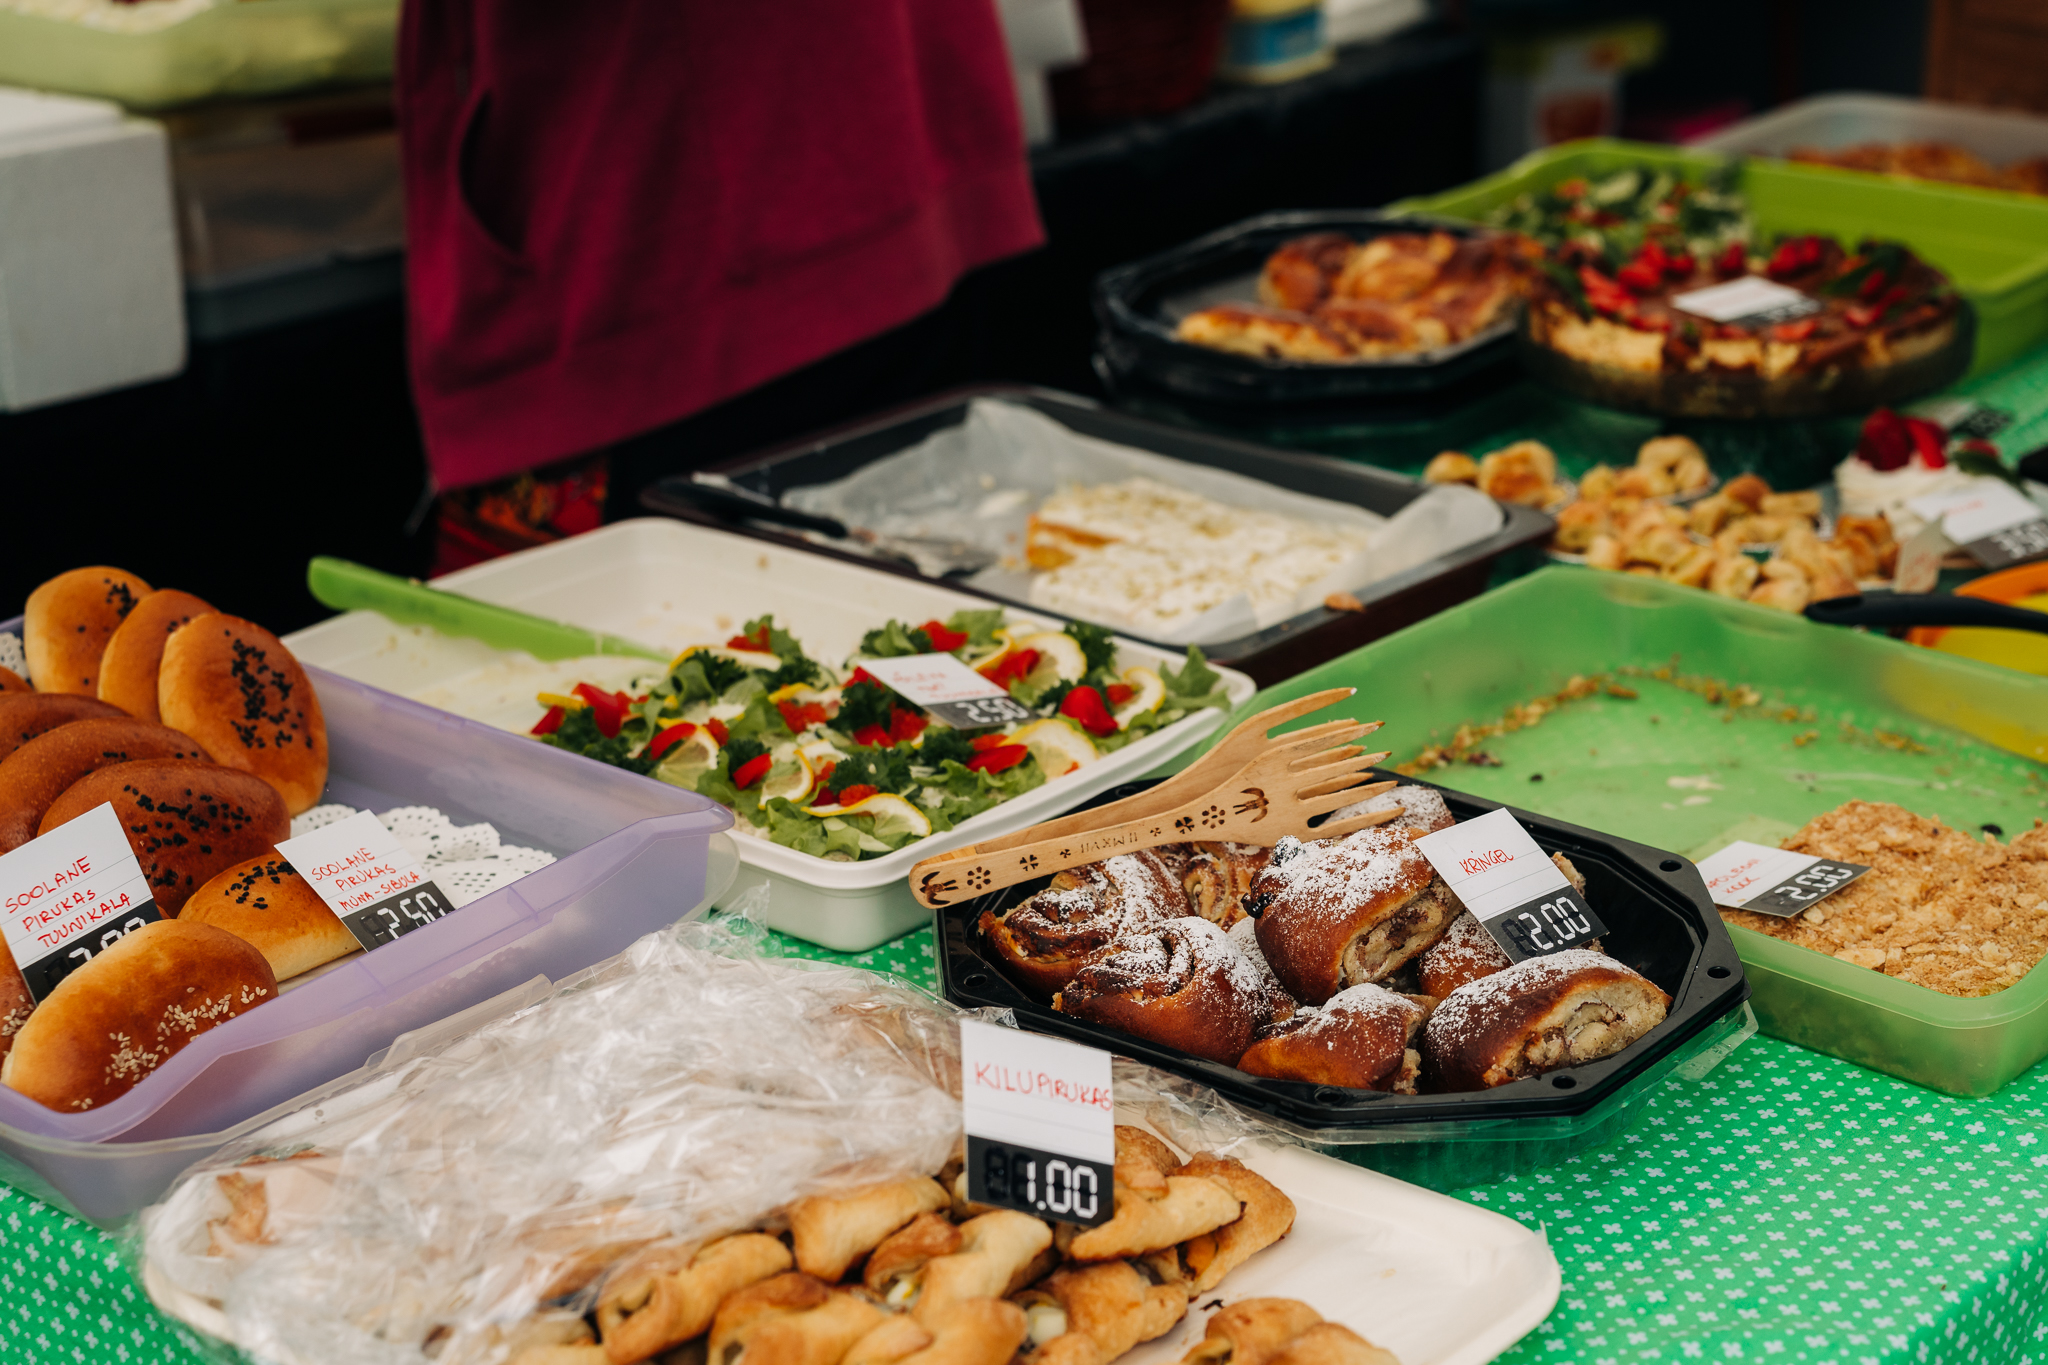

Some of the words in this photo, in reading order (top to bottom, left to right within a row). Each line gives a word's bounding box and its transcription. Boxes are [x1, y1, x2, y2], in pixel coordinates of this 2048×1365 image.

[5, 855, 91, 914] SOOLANE
[311, 847, 375, 881] SOOLANE
[335, 863, 397, 891] PIRUKAS
[22, 889, 96, 932] PIRUKAS
[37, 892, 131, 948] TUUNIKALA
[1518, 896, 1592, 950] 2.00
[974, 1060, 1113, 1112] KILUPIRUKAS
[1026, 1159, 1098, 1219] 1.00
